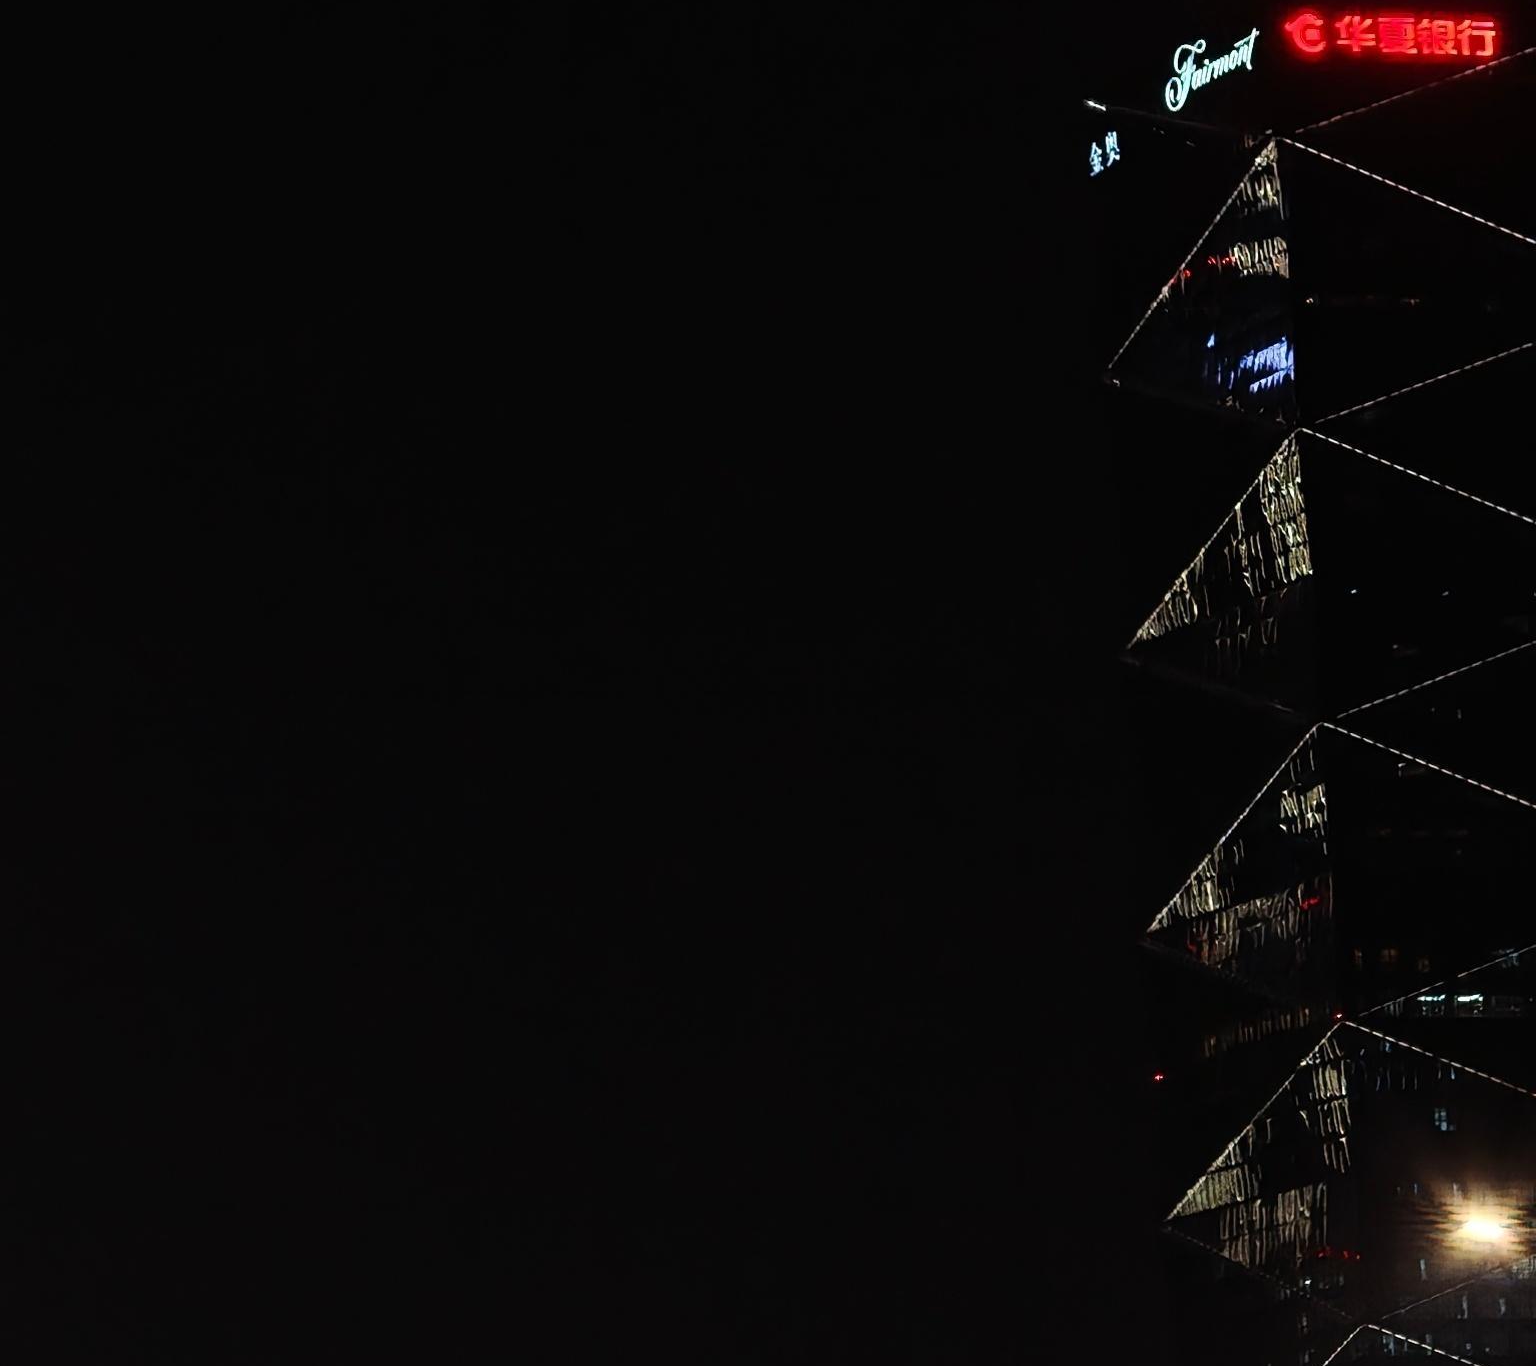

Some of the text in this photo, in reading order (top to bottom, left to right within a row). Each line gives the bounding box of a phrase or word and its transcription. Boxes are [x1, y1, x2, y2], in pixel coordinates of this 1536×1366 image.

[1334, 14, 1497, 57] 华夏银行
[1165, 27, 1260, 112] Fairmont
